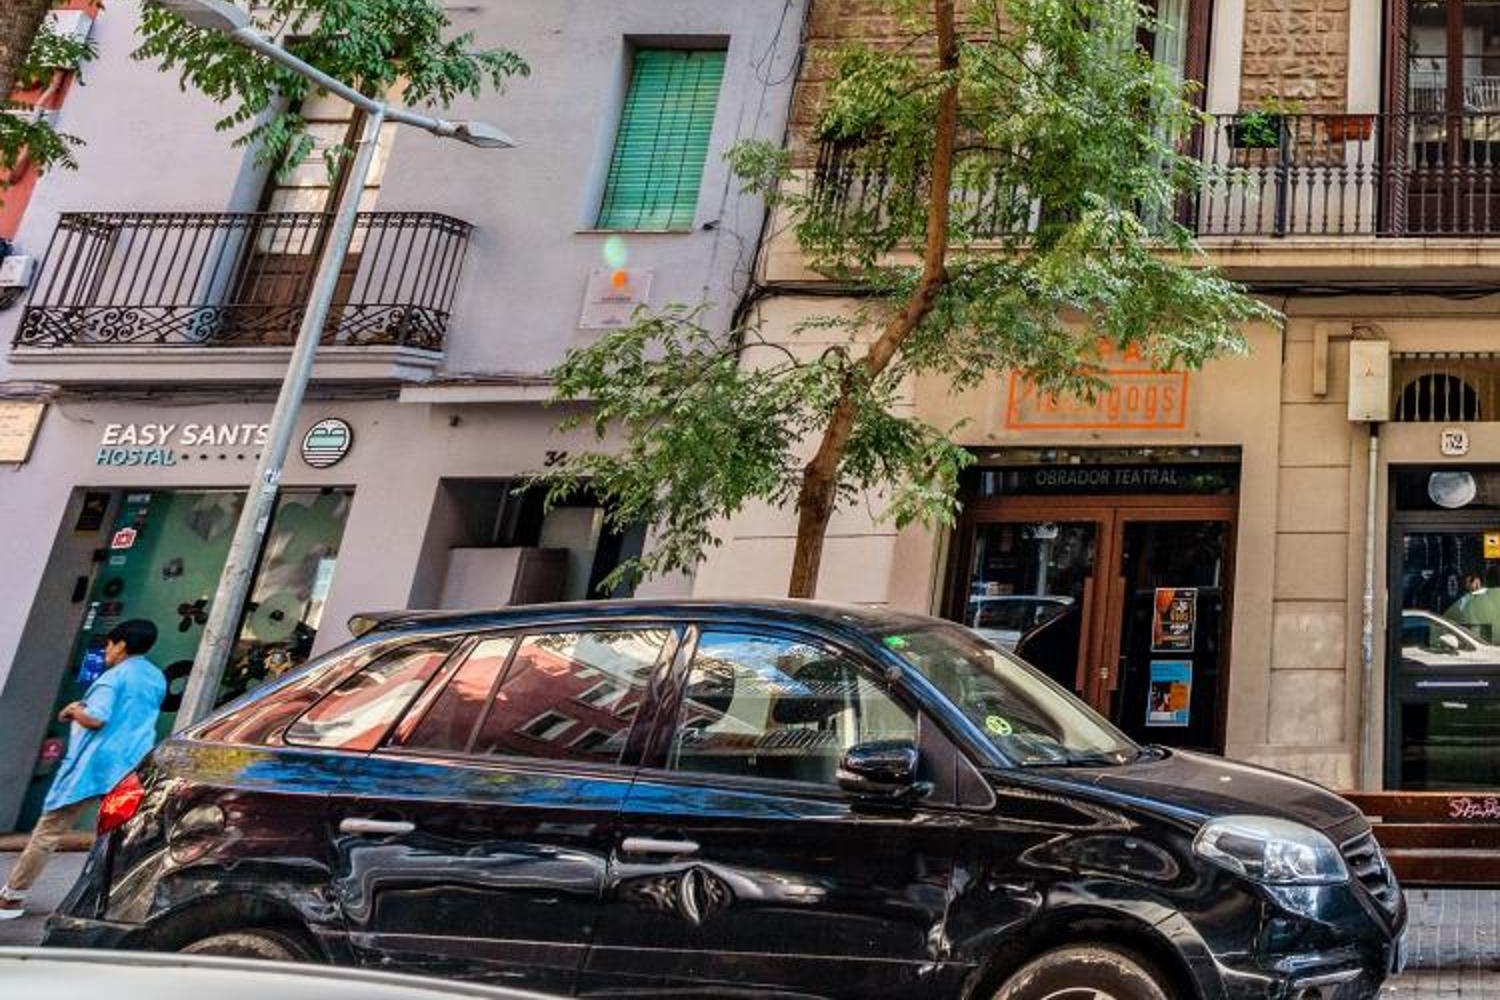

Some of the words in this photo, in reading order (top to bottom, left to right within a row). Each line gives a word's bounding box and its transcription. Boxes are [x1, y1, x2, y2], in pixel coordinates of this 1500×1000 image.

[102, 423, 175, 446] EASY
[181, 423, 271, 446] SANTS
[1445, 433, 1463, 450] 32
[95, 449, 176, 466] HOSTAL
[1036, 469, 1109, 486] OBRADOR
[1114, 468, 1178, 486] TEATRAL
